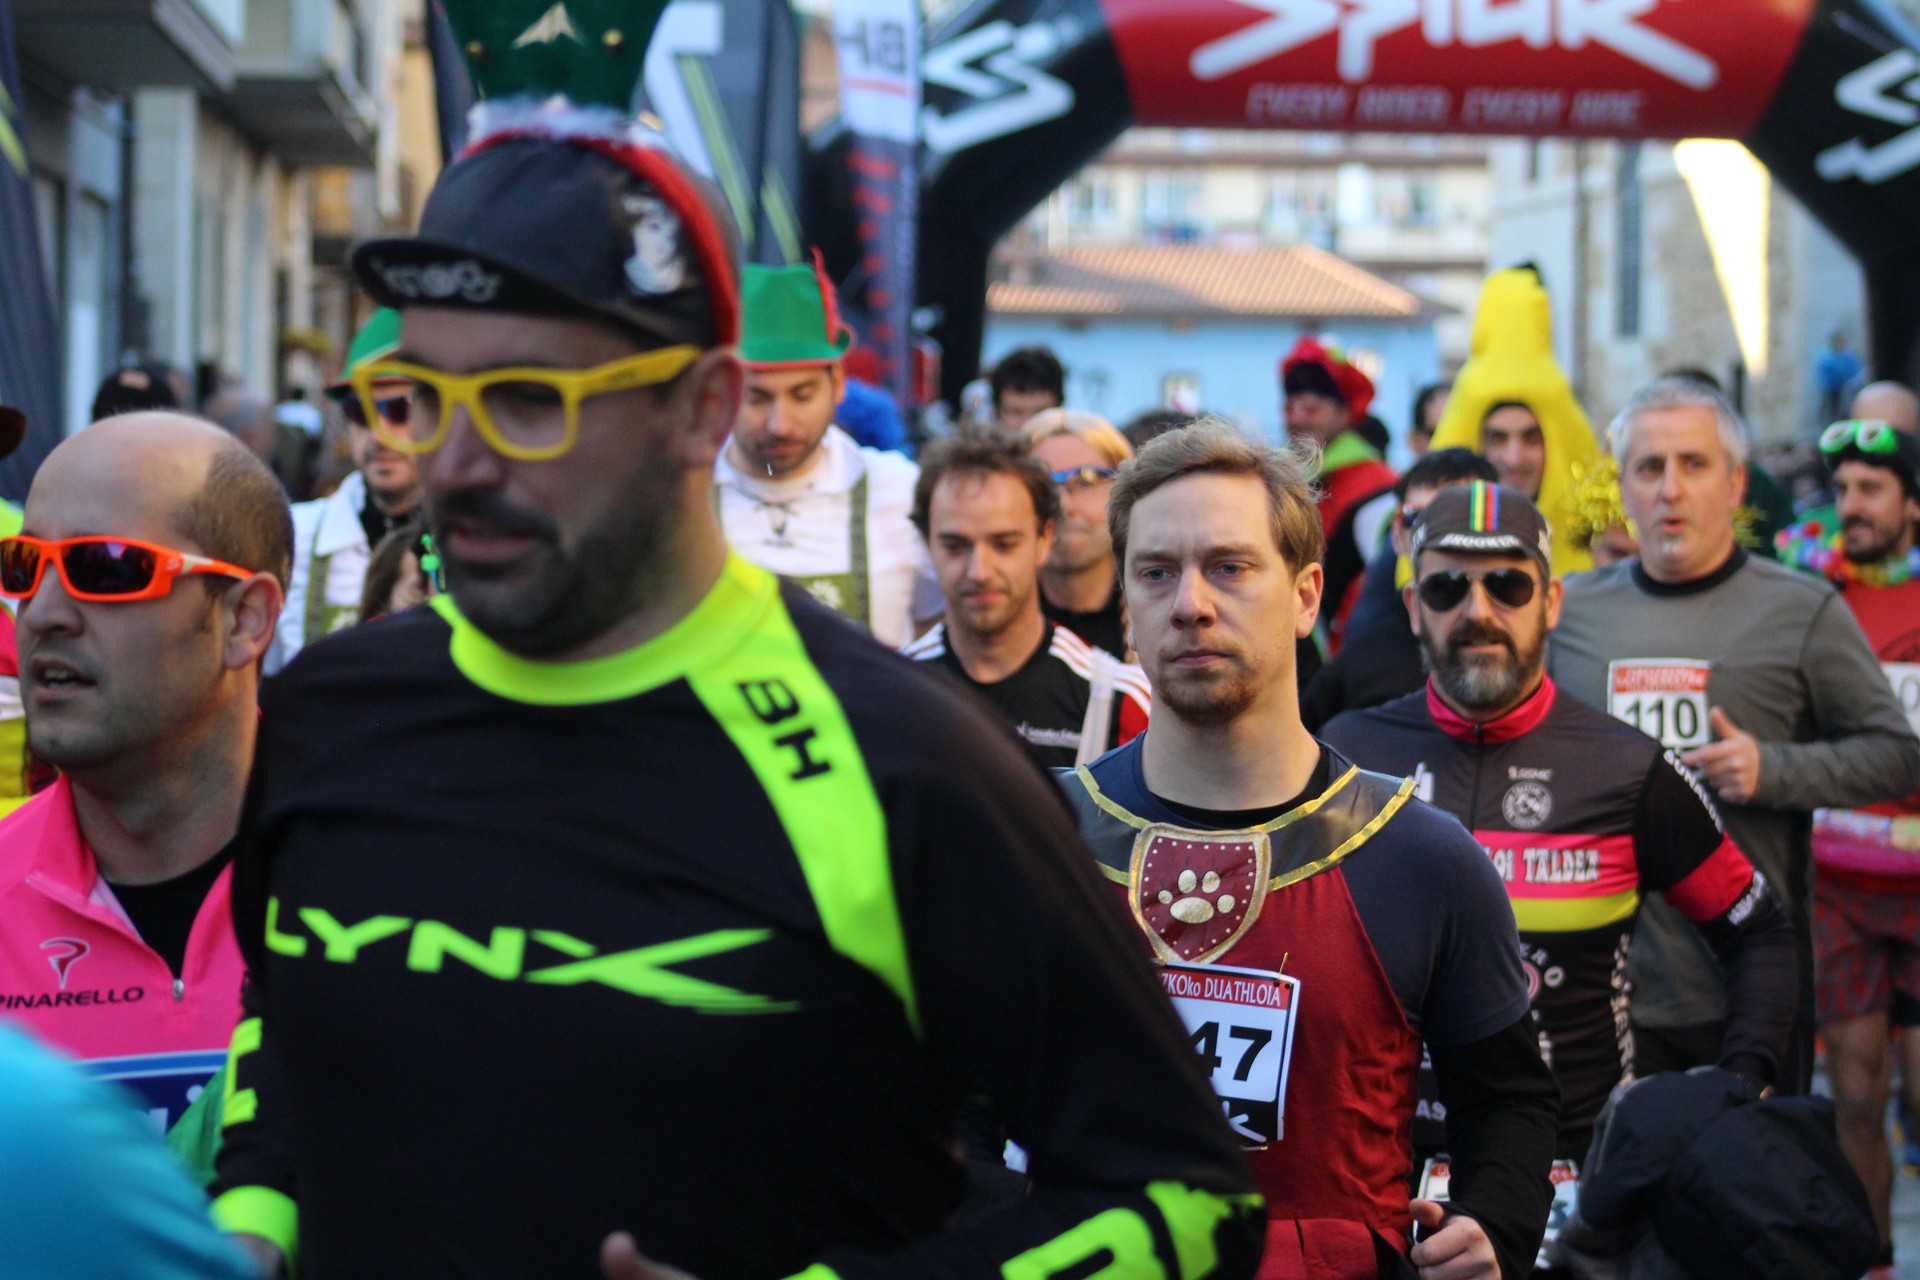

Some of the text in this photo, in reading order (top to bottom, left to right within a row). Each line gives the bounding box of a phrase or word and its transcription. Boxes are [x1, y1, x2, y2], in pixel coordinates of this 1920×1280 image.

[736, 680, 831, 780] BH
[1625, 697, 1698, 739] 110
[265, 896, 800, 1014] LYNX
[1203, 977, 1281, 1007] DUATHLOIA
